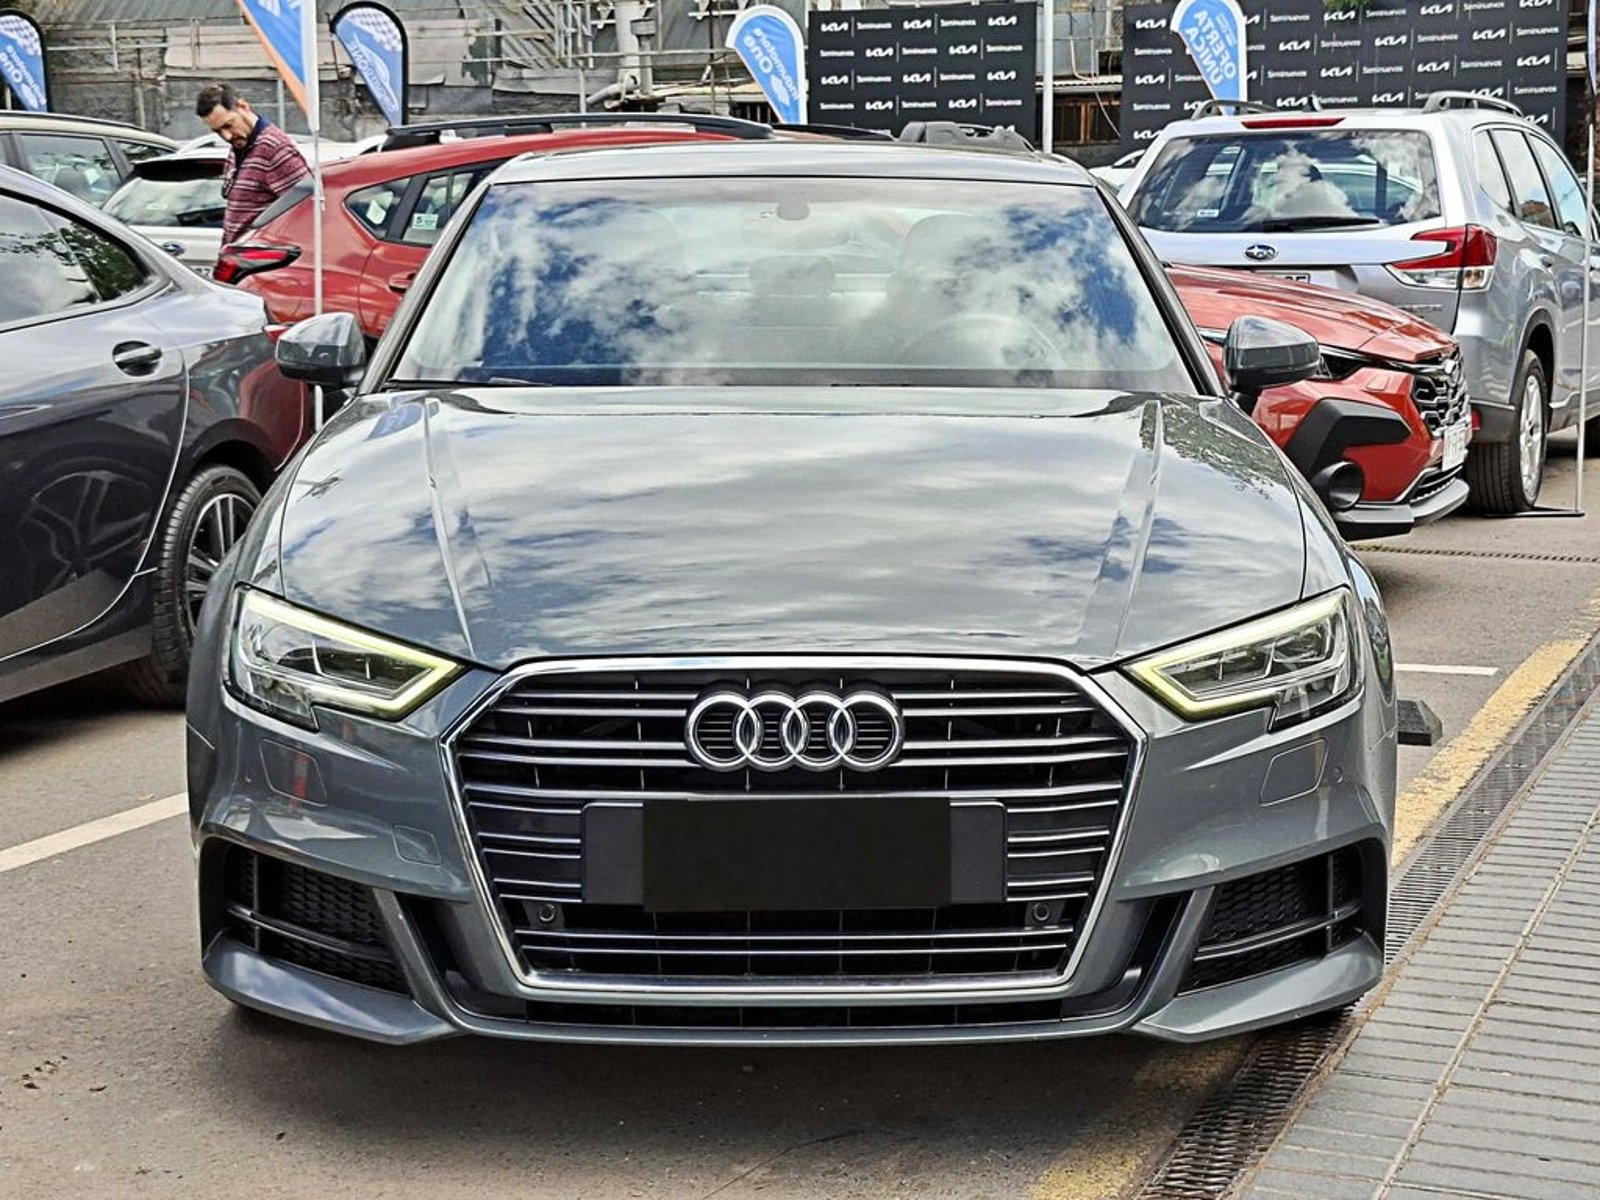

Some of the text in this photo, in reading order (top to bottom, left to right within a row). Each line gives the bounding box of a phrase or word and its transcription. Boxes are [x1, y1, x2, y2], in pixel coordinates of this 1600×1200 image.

[1420, 4, 1453, 15] KIA
[988, 16, 1017, 26] KIA
[1324, 11, 1355, 22] KIA
[821, 22, 848, 32] KIA
[903, 19, 931, 29] KIA
[1136, 19, 1166, 28] KIA
[1473, 29, 1505, 40] KIA
[1279, 40, 1310, 50] KIA
[1375, 35, 1407, 46] KIA
[866, 47, 893, 57] KIA
[949, 45, 977, 54] KIA
[1517, 55, 1550, 66] KIA
[1321, 66, 1352, 77] KIA
[1417, 61, 1450, 72] KIA
[821, 75, 848, 84] KIA
[903, 73, 931, 83] KIA
[987, 71, 1016, 80] KIA
[1135, 74, 1165, 84] KIA
[1276, 97, 1308, 106] KIA
[1372, 92, 1404, 103] KIA
[865, 101, 893, 110] KIA
[948, 99, 977, 108] KIA
